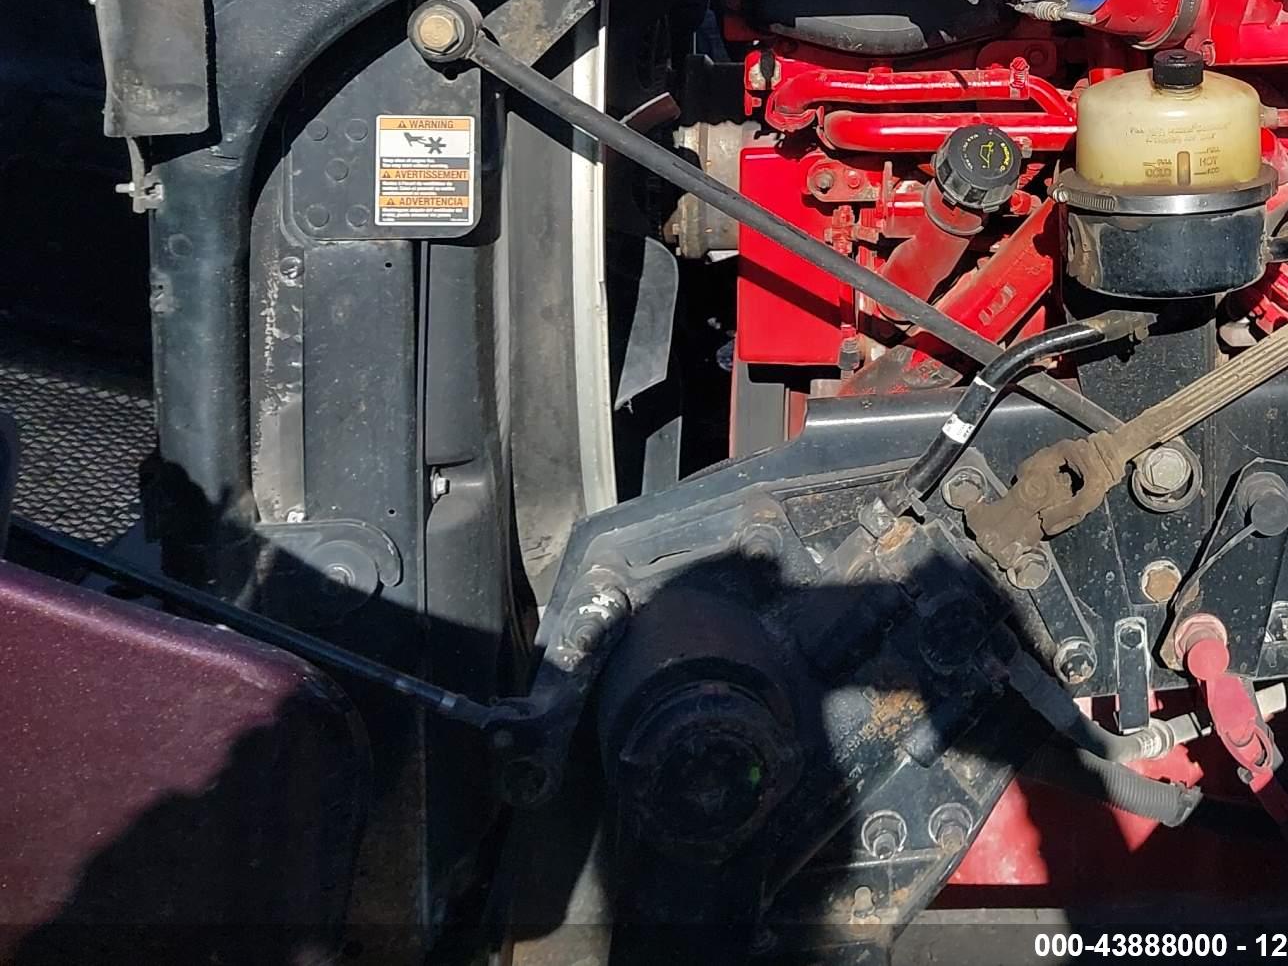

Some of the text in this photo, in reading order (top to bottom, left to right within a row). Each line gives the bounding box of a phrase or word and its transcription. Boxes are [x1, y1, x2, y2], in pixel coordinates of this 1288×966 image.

[409, 120, 454, 129] WARNING
[395, 170, 468, 179] AVERTISSEMENT
[400, 197, 463, 206] ADVERTENCIA
